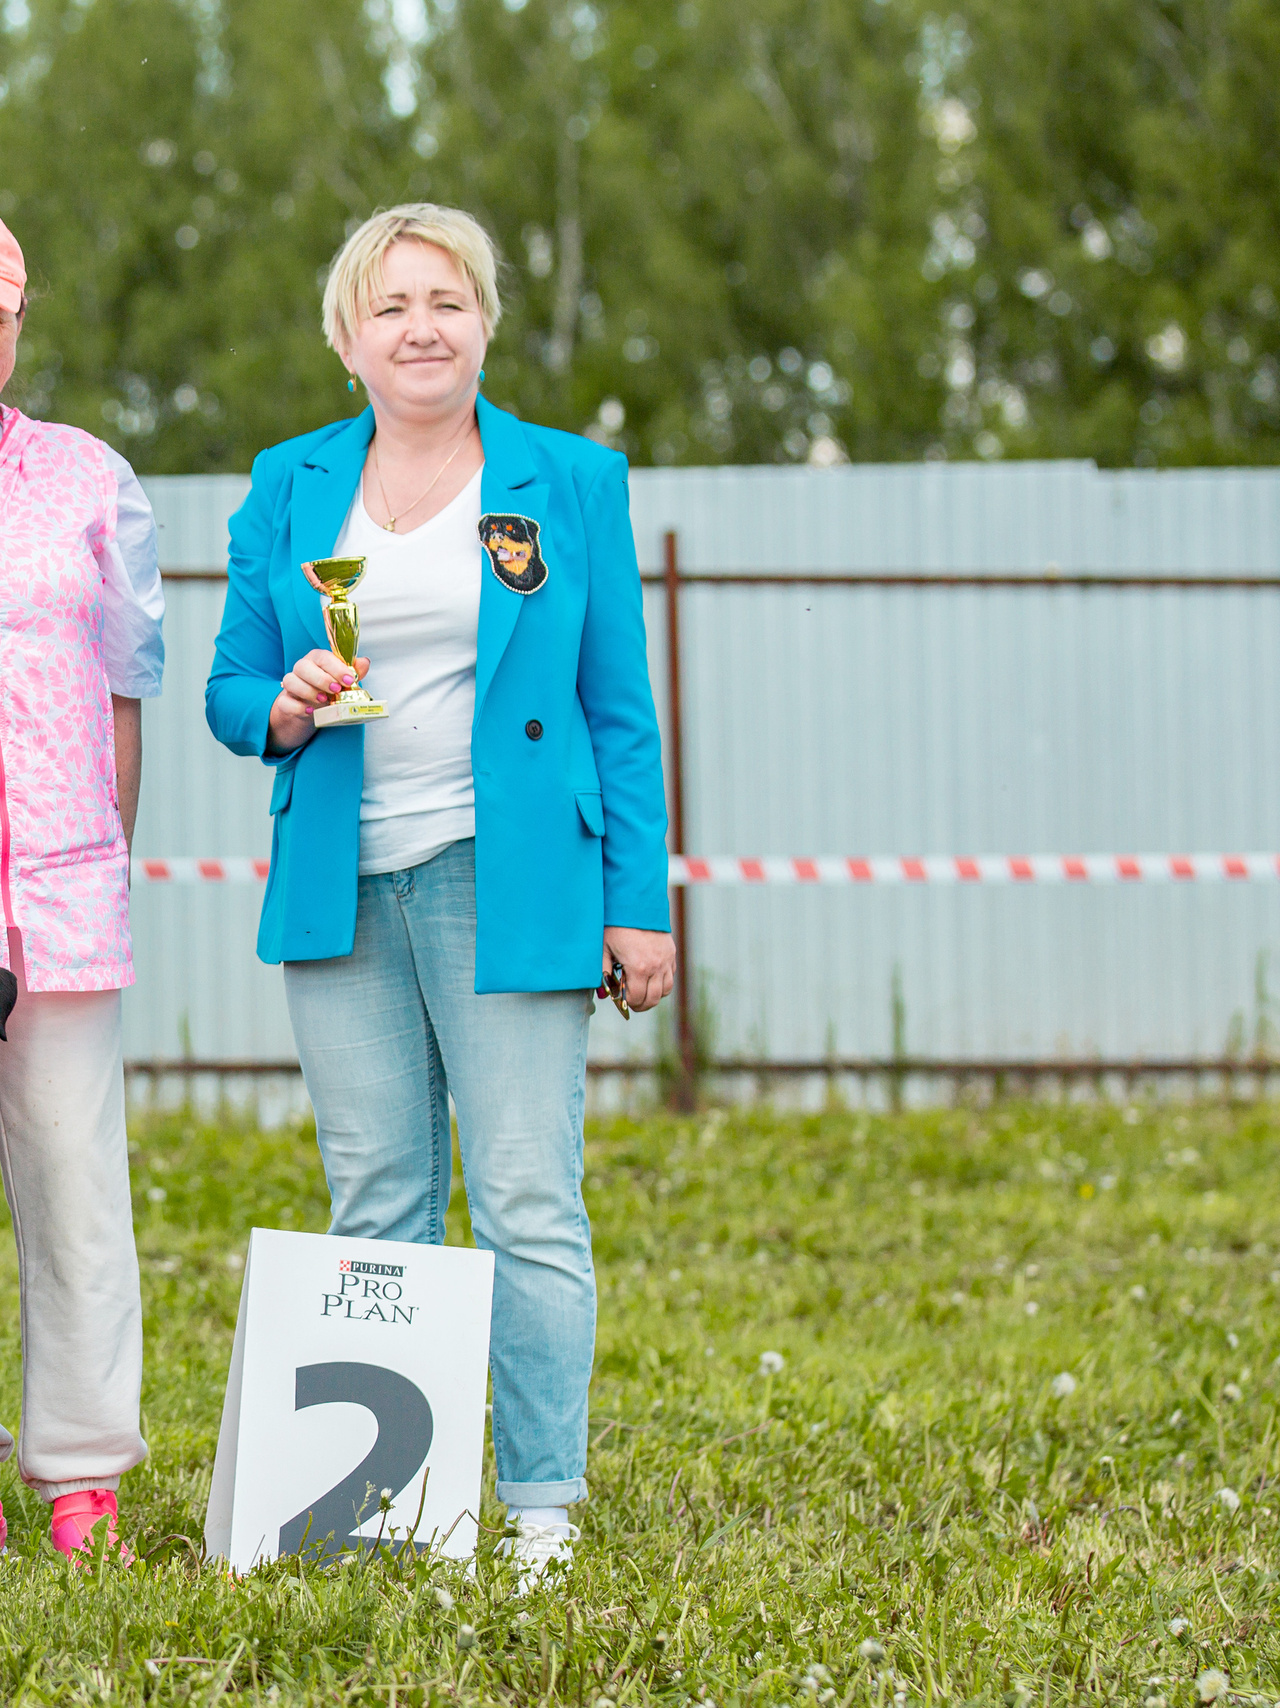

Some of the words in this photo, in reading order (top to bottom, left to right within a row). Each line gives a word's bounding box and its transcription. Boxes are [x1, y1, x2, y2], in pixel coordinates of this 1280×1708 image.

[352, 1261, 402, 1277] PURINA
[337, 1272, 403, 1301] PRO
[320, 1293, 416, 1325] PLAN
[278, 1361, 434, 1566] 2
